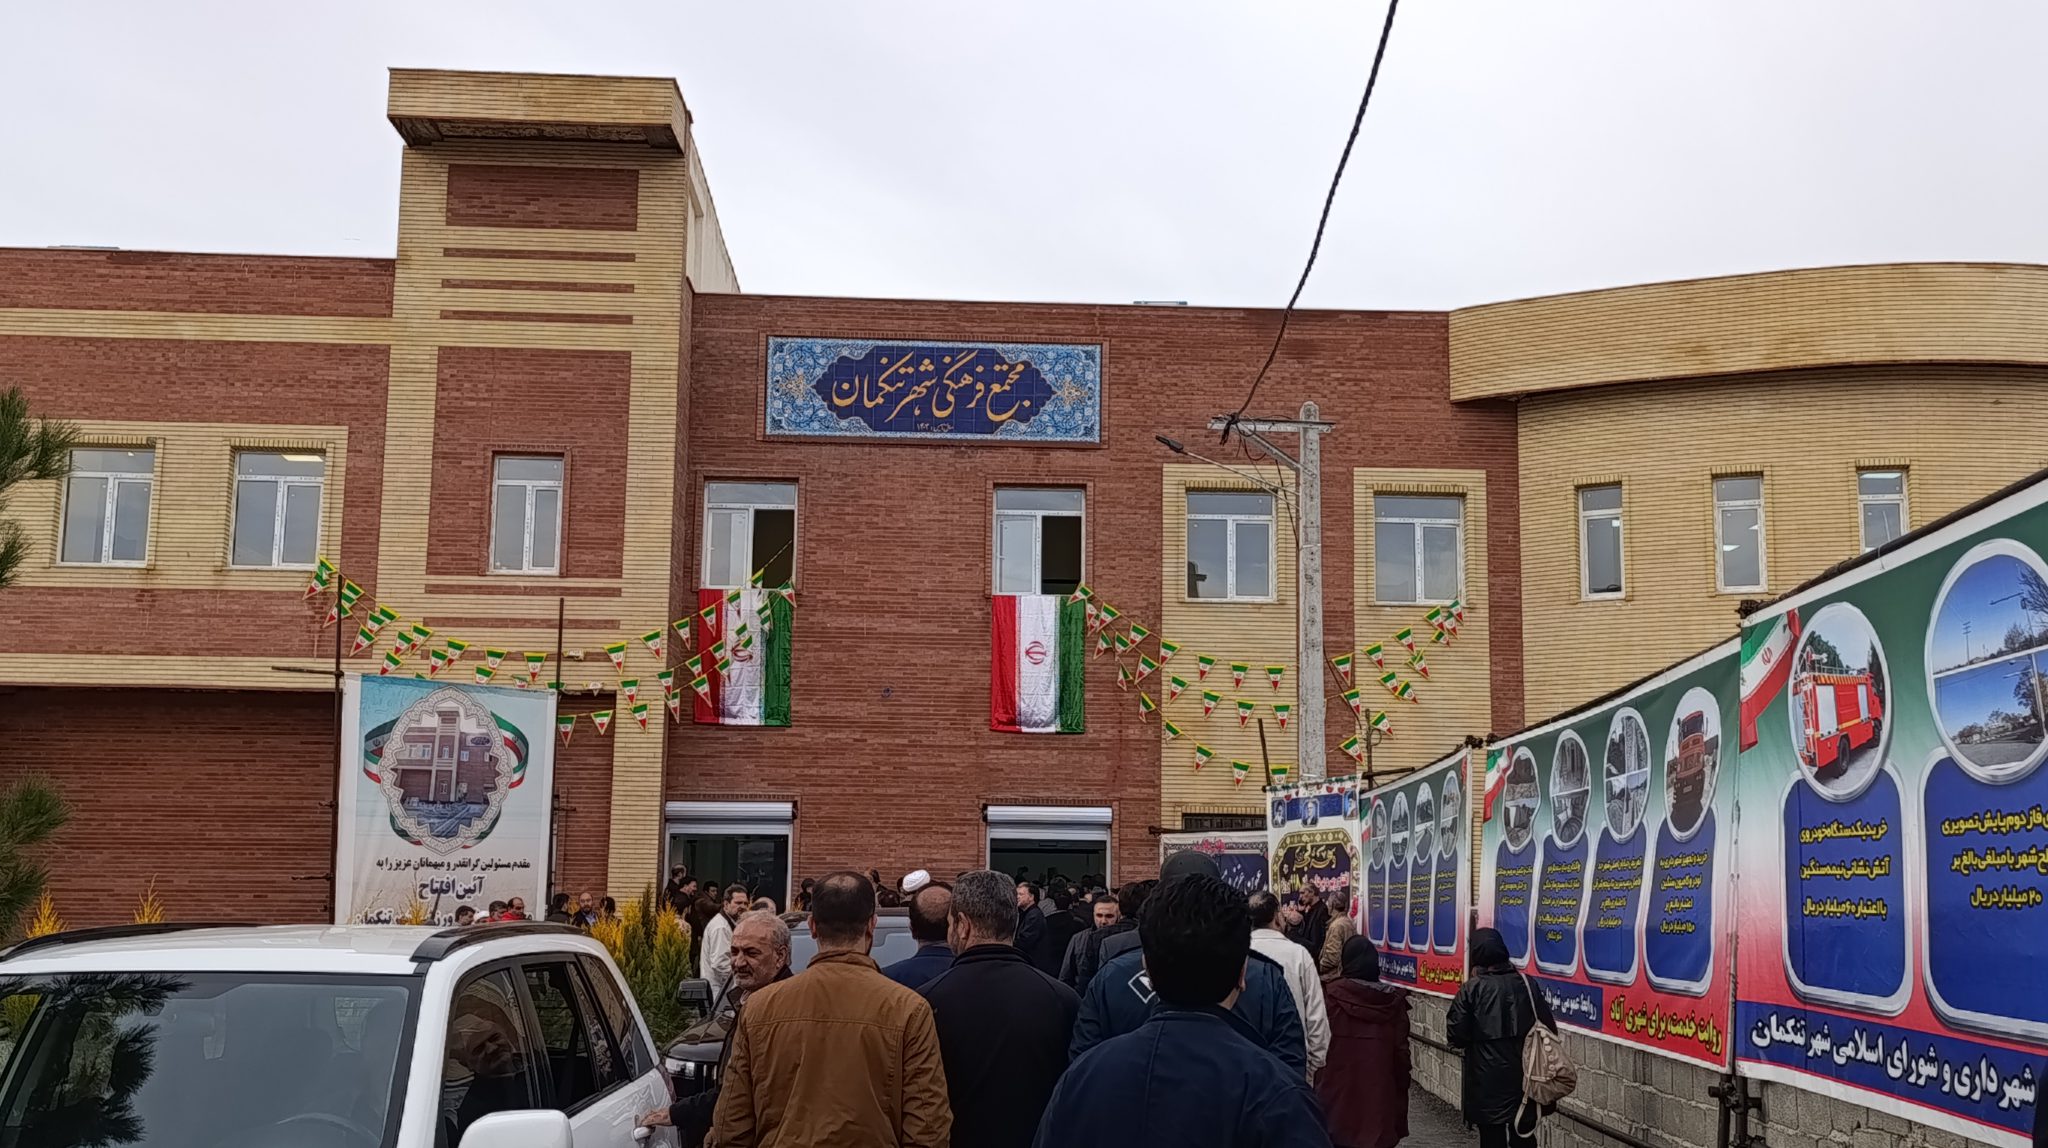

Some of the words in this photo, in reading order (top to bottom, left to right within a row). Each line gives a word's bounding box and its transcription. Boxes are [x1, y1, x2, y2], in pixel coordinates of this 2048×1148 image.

[832, 350, 915, 409] تنکمان
[884, 358, 938, 423] شهر
[932, 349, 985, 418] فرهنگی
[986, 363, 1031, 422] مجتمع
[1866, 818, 1889, 840] خرید
[1941, 813, 1980, 835] تصویری
[1979, 810, 2007, 834] پایش
[2007, 811, 2027, 831] دوم
[2026, 806, 2043, 830] فاز
[1799, 823, 1827, 843] خودروی
[376, 859, 385, 871] به
[385, 858, 393, 871] را
[393, 858, 412, 872] عزیز
[412, 857, 445, 872] میهمانان
[445, 861, 451, 871] و
[452, 857, 481, 872] گرانقدر
[480, 857, 511, 872] مسئولین
[512, 858, 531, 872] مقدم
[1951, 856, 1961, 870] بر
[1960, 849, 1978, 875] بالغ
[1978, 848, 2007, 870] مبلغی
[2007, 848, 2015, 869] با
[2015, 846, 2038, 869] شهر
[1970, 886, 1993, 907] ریال
[1993, 886, 2029, 908] میلیارد
[1610, 994, 1626, 1026] آباد
[1625, 1003, 1648, 1033] شهری
[1649, 1006, 1667, 1039] برای
[1752, 1013, 1806, 1048] تنکمان
[1698, 1014, 1723, 1054] روایت
[1807, 1024, 1831, 1057] شهر
[1833, 1028, 1884, 1066] اسلامی
[1886, 1039, 1938, 1086] شورای
[1941, 1063, 1951, 1093] و
